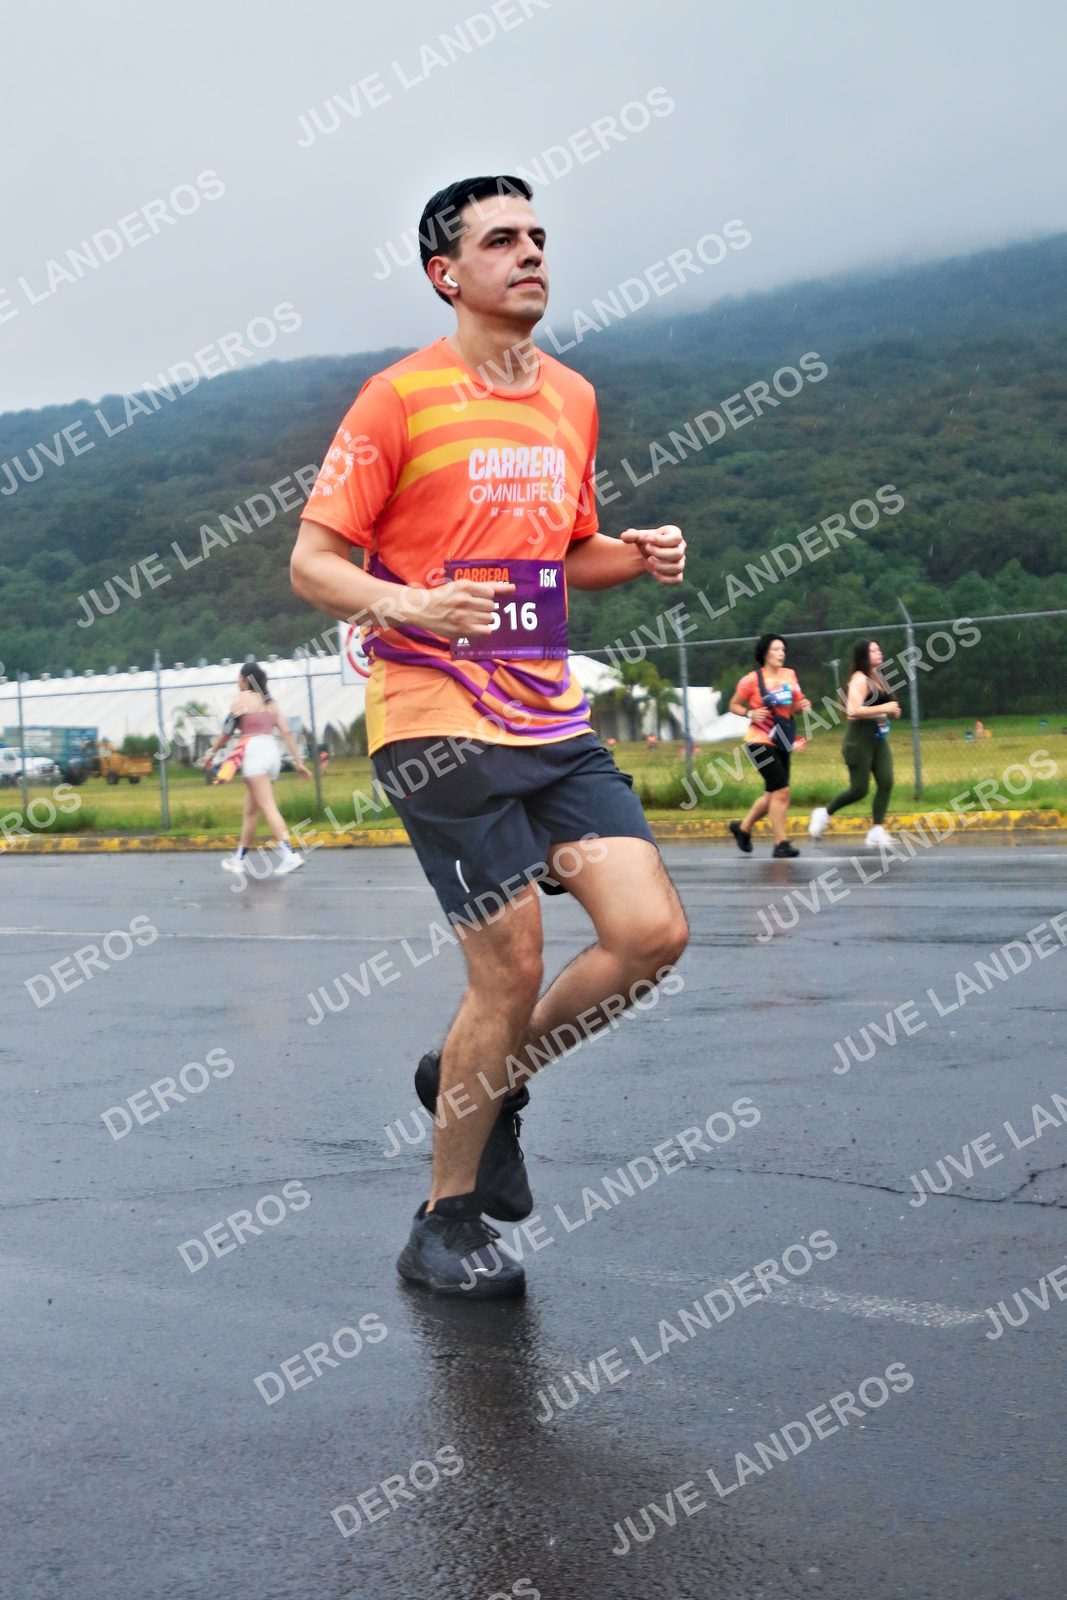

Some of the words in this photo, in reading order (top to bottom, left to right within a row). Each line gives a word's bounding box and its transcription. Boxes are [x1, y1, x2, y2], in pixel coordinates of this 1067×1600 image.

[469, 446, 566, 481] CARRERA
[454, 567, 510, 583] CARRERA
[539, 568, 557, 588] 15K
